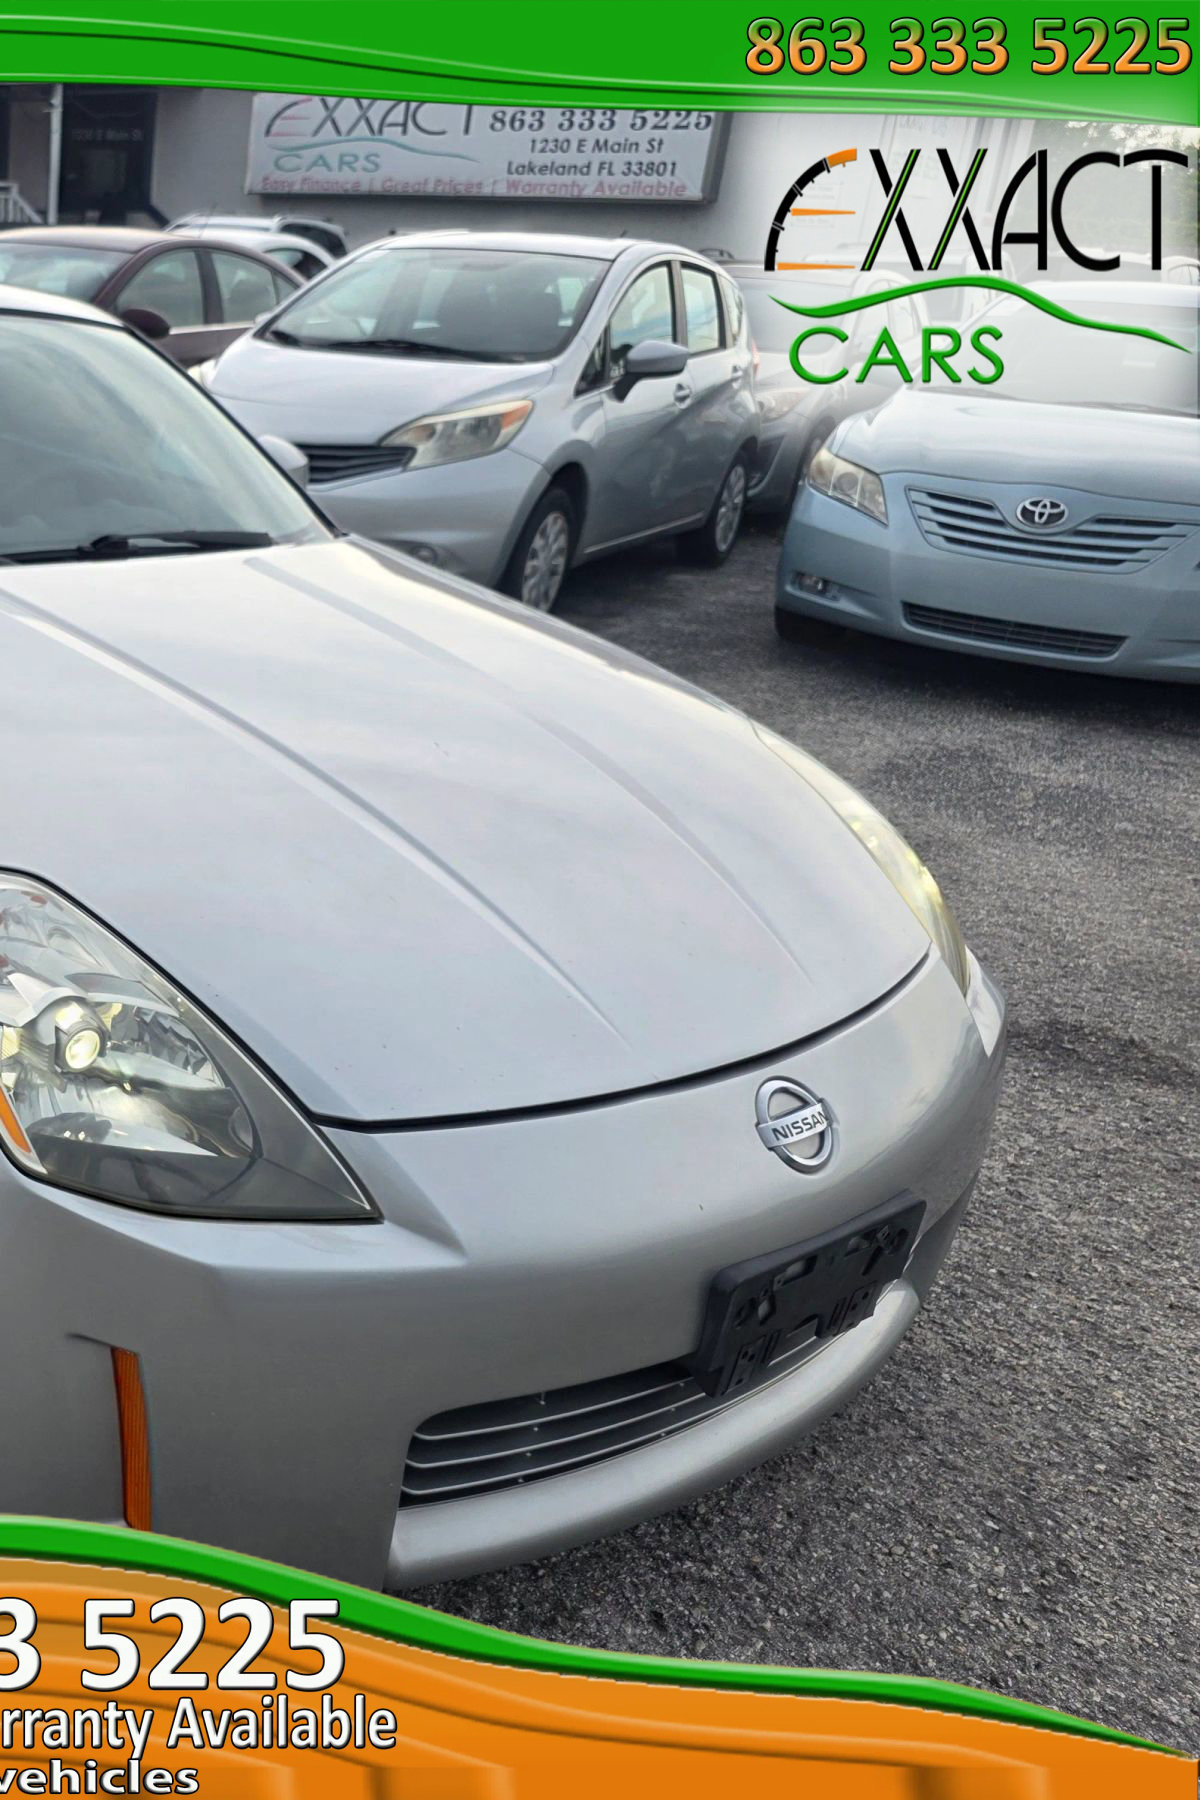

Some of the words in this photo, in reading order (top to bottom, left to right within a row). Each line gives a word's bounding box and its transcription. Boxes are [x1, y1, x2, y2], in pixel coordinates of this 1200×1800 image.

[489, 109, 545, 132] 863
[557, 109, 616, 132] 333
[630, 110, 712, 131] 5225
[530, 138, 571, 154] 1230
[576, 139, 588, 154] E
[591, 139, 640, 154] Main
[645, 138, 664, 154] St
[273, 152, 382, 174] CARS
[506, 161, 591, 177] Lakeland
[597, 162, 615, 177] FL
[621, 161, 677, 177] 33801
[505, 179, 587, 198] Warranty
[594, 180, 687, 197] Available
[771, 1111, 828, 1141] NISSAN
